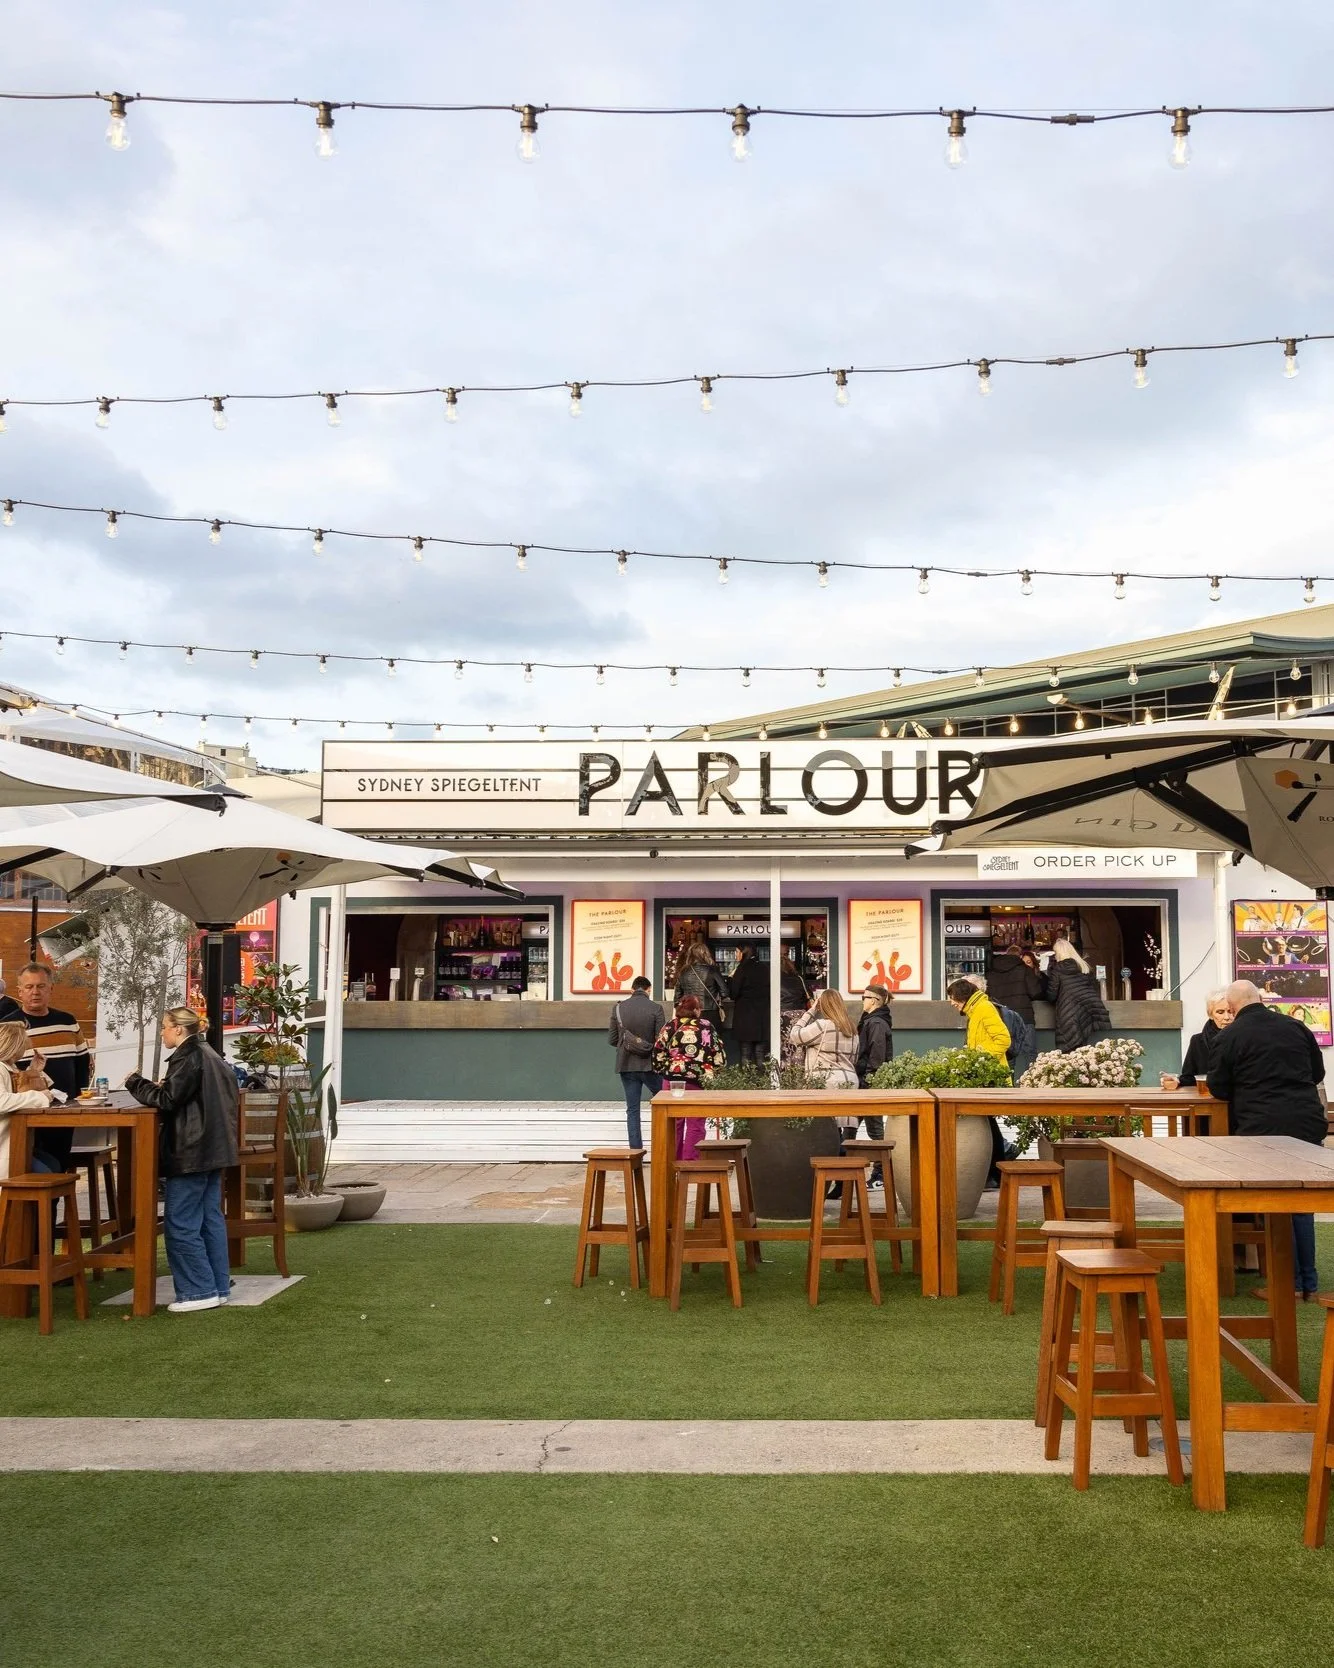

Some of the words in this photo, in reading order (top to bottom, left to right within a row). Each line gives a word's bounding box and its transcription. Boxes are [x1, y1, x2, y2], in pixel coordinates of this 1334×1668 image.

[357, 778, 424, 792] SYDNEY
[431, 778, 541, 792] SPIEGELTENT
[578, 750, 981, 816] PARLOUR
[1033, 855, 1096, 868] ORDER
[1104, 855, 1145, 867] PICK
[1152, 855, 1177, 867] UP
[726, 925, 771, 934] PARLOU
[945, 924, 971, 933] OUR
